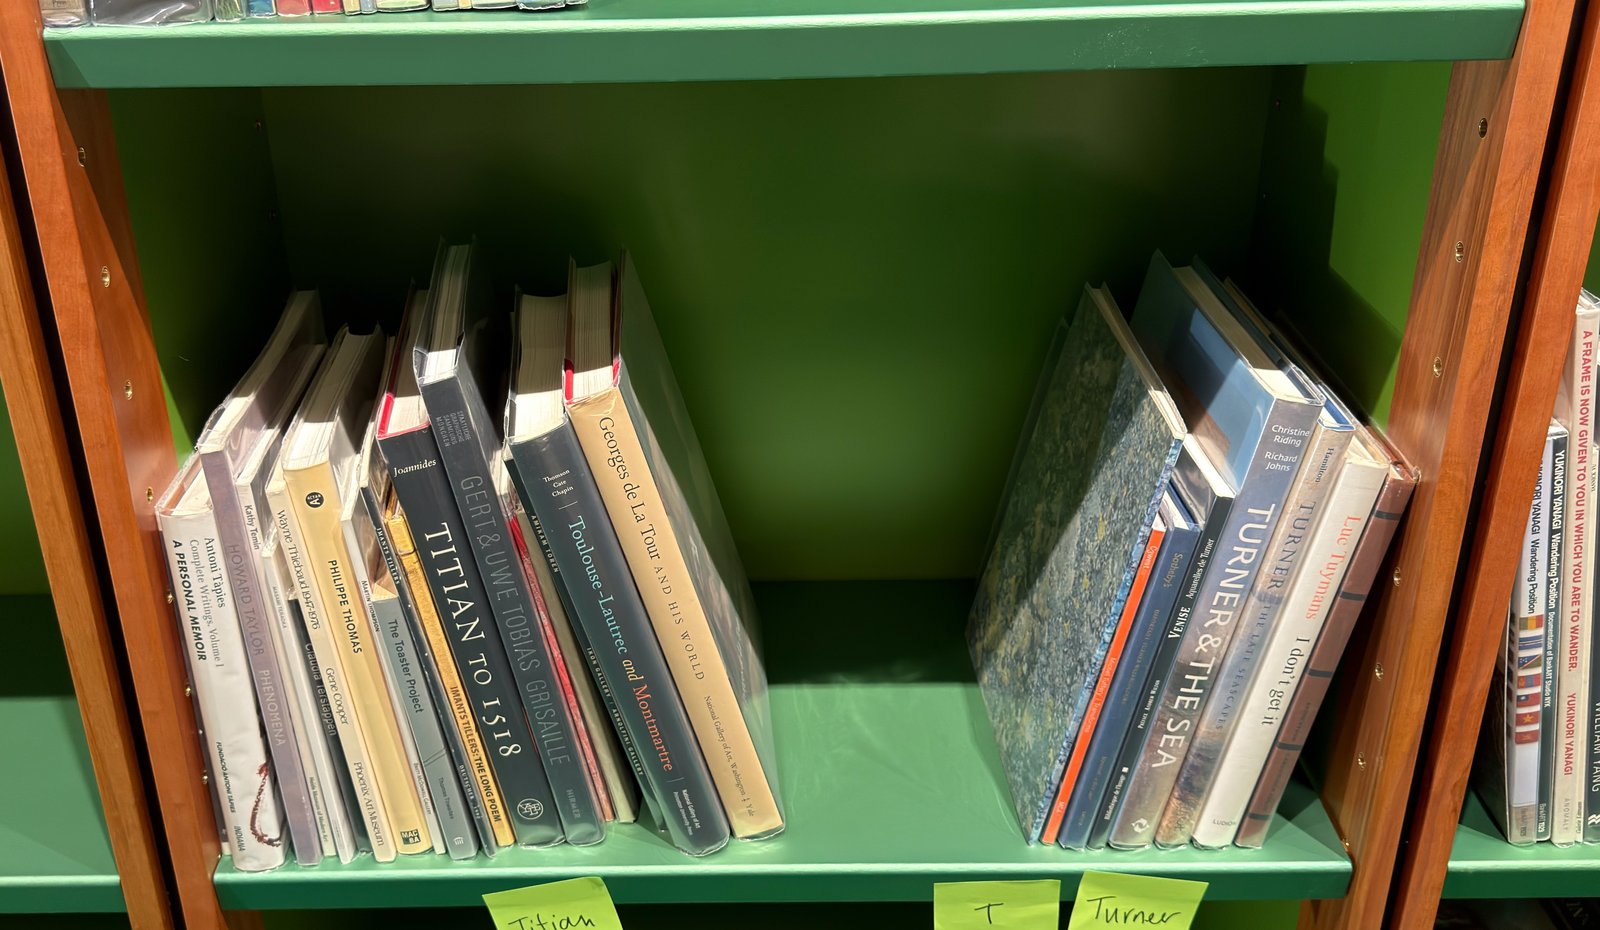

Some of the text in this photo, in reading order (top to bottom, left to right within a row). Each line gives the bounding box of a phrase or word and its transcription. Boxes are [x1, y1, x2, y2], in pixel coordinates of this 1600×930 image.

[1272, 424, 1310, 436] Christine
[1274, 435, 1301, 447] Riding
[394, 458, 436, 477] Joannides
[542, 470, 570, 482] Thomson
[1265, 452, 1298, 462] Richard
[1265, 462, 1291, 472] Johns
[1315, 448, 1334, 483] Hamilton
[1554, 450, 1565, 494] YUKINORI
[461, 476, 496, 530] GERT
[552, 480, 566, 488] Cate
[552, 486, 574, 496] Chapin
[1568, 330, 1592, 672] A FRAME IS NOW GIVEN TO YOU IN WHICH YOU ARE TO WANDER.
[244, 504, 260, 550] Kathy Temin
[1531, 500, 1541, 536] YANAGI
[1552, 496, 1562, 530] YANAGI
[277, 510, 292, 543] Wayne
[288, 544, 308, 590] Thiebaud
[376, 528, 400, 585] IMANTS TILLERS
[476, 534, 500, 550] &
[600, 417, 704, 681] Georges de La Tour AND HIS WORLD
[1527, 538, 1540, 582] Wandering
[1548, 533, 1560, 576] Wandering
[204, 538, 225, 608] Antoni Tàpies
[485, 551, 518, 600] UWE
[1164, 552, 1183, 588] Sotheby's
[1186, 538, 1214, 599] Aquarelles de Turner
[1306, 516, 1361, 620] Luc Tuymans
[172, 540, 207, 661] A PERSONAL MEMOIR
[190, 539, 204, 582] Complete
[209, 629, 220, 662] Volume
[328, 560, 362, 654] PHILIPPE THOMAS
[361, 580, 380, 632] MARTIN THOMPSON
[1528, 582, 1538, 614] Position
[1548, 577, 1559, 608] Position
[1151, 503, 1276, 768] TURNER & THE SEA
[1168, 606, 1190, 639] VENISE
[1216, 502, 1316, 730] TURNER THE LATE SEASCAPES
[1546, 612, 1556, 650] Documentation
[229, 544, 286, 746] HOWARD TAYLOR PHENOMENA
[424, 522, 522, 756] TITIAN TO 1518
[502, 604, 540, 672] TOBIAS
[568, 515, 672, 771] Toulouse-Lautrec and Montmartre
[388, 619, 424, 714] The Toaster Project
[1278, 647, 1304, 686] don't
[1544, 680, 1552, 696] Studio
[1545, 656, 1554, 679] BankART
[326, 667, 349, 725] Gene Cooper
[1269, 689, 1284, 712] get
[1544, 696, 1552, 708] NYK
[526, 680, 570, 766] GRISAILLE
[1262, 714, 1278, 726] it
[1564, 692, 1576, 776] YUKINORI YANAGI
[450, 686, 502, 822] IMANTS TILLERS: THE LONG POEM
[354, 762, 384, 846] Phoenix Art Museum
[234, 826, 246, 851] INDIANA
[401, 830, 418, 838] MAC
[508, 913, 595, 930] Titian
[974, 903, 1004, 924] T
[1087, 896, 1182, 924] Turner
